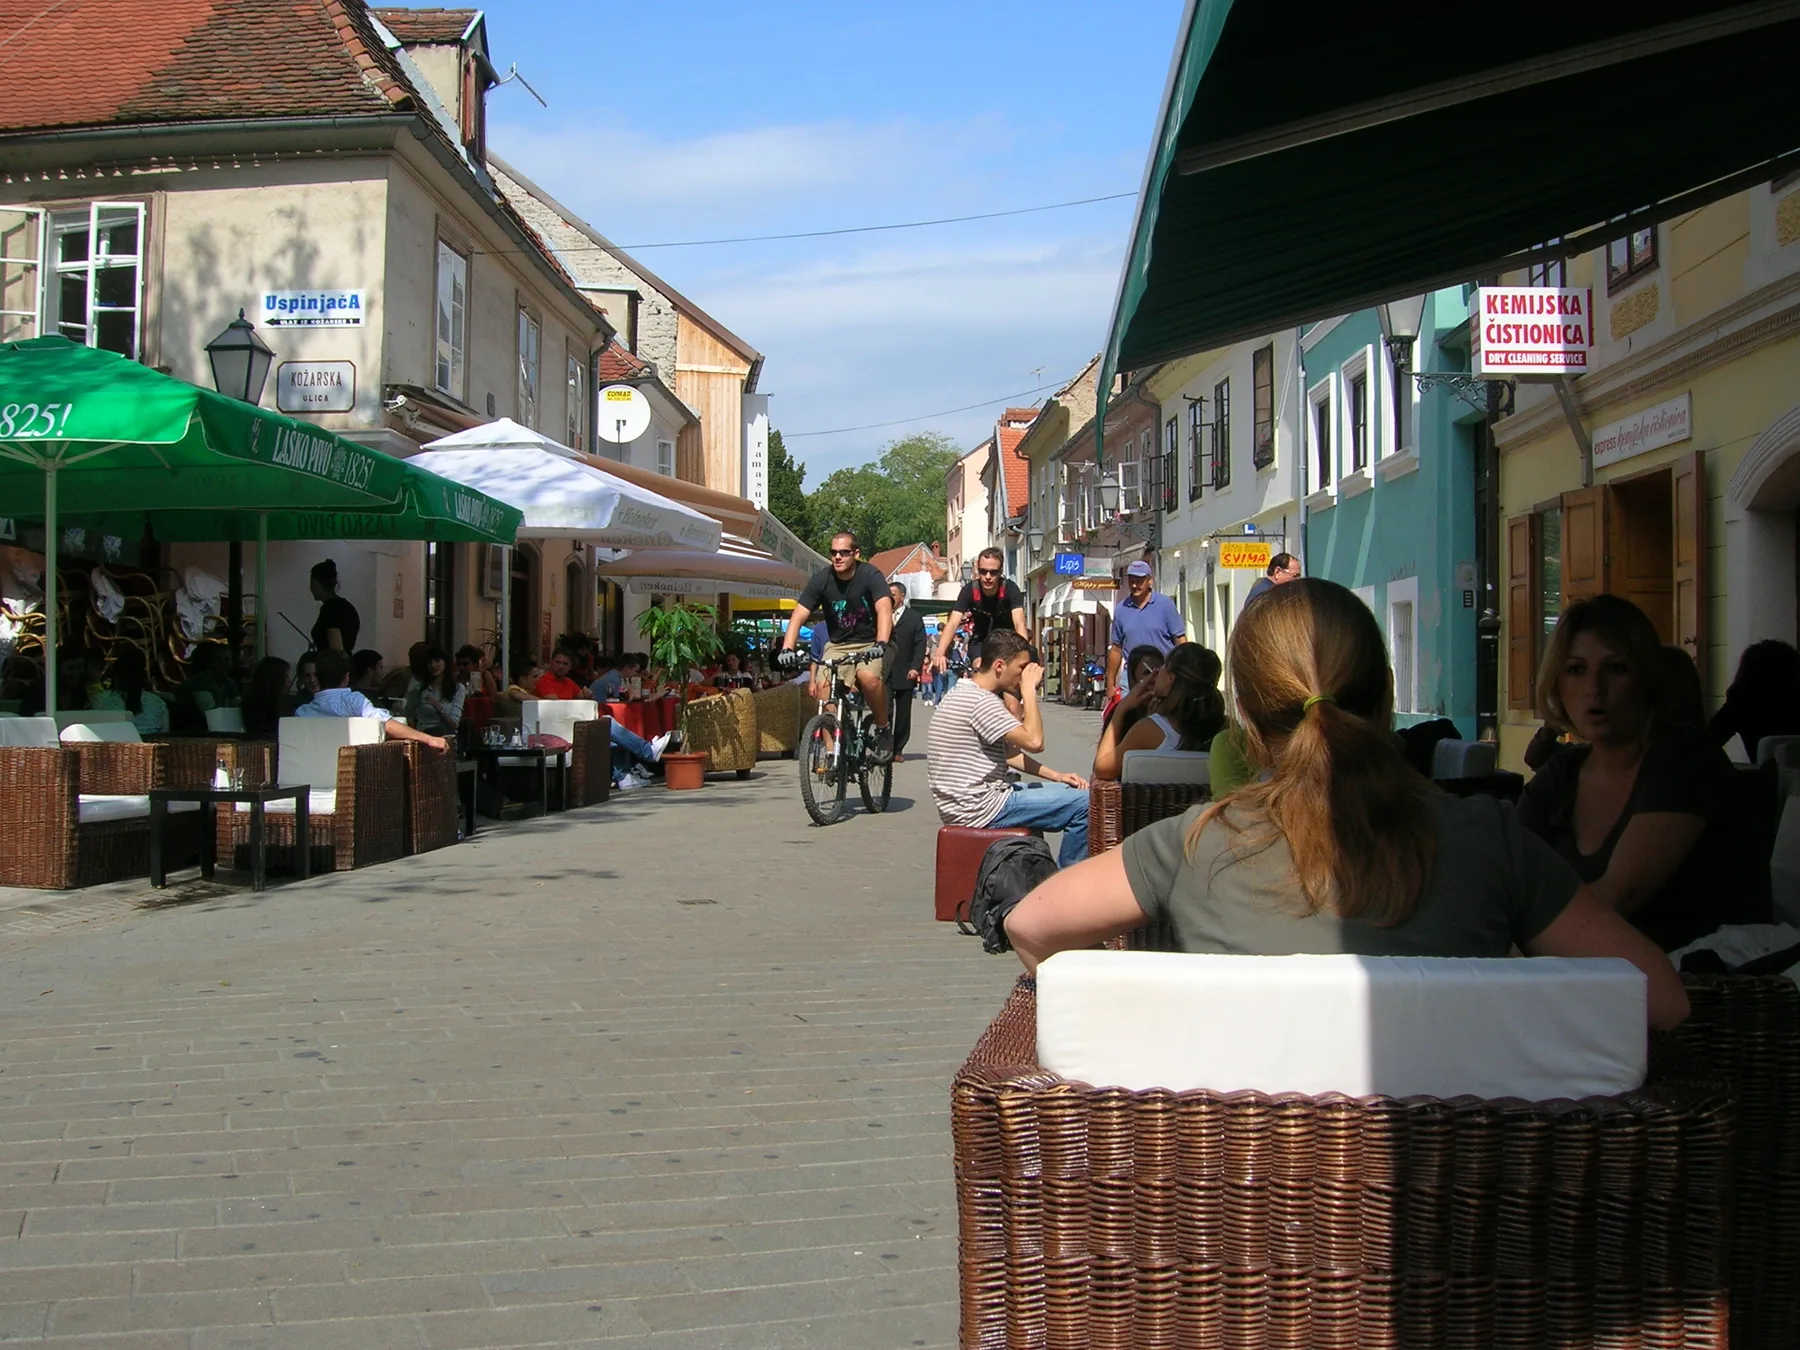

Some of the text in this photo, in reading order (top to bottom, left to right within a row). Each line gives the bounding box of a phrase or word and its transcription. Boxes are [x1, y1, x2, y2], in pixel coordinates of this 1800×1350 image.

[1486, 295, 1582, 314] KEMIJSKA
[1486, 318, 1584, 344] ČISTIONICA
[1488, 353, 1583, 364] DRY CLEANING SERVICE
[291, 369, 342, 387] KOŽARSKA
[302, 394, 329, 402] ULICA
[1594, 436, 1616, 455] express
[271, 421, 309, 469] LAŠKO
[307, 437, 333, 476] PIVO
[343, 451, 376, 490] 1825!
[751, 441, 762, 504] ramasu
